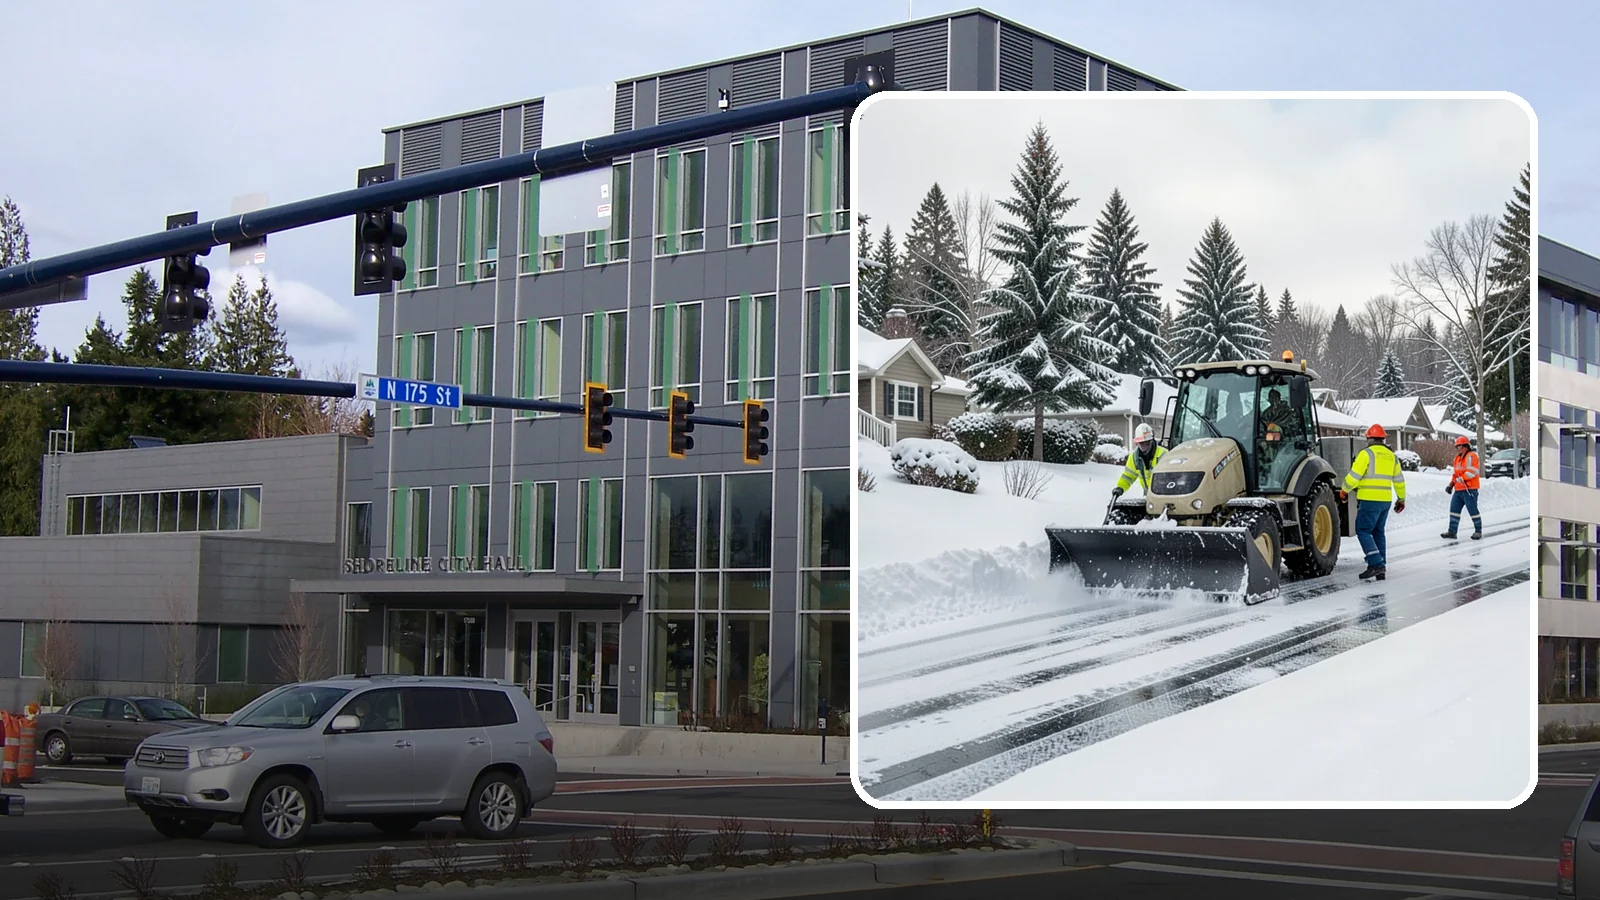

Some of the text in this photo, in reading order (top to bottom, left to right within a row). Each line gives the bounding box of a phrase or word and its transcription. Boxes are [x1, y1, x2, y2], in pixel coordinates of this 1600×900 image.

[388, 381, 451, 406] N 175 St
[344, 554, 525, 574] SHORELINE CITY HALL
